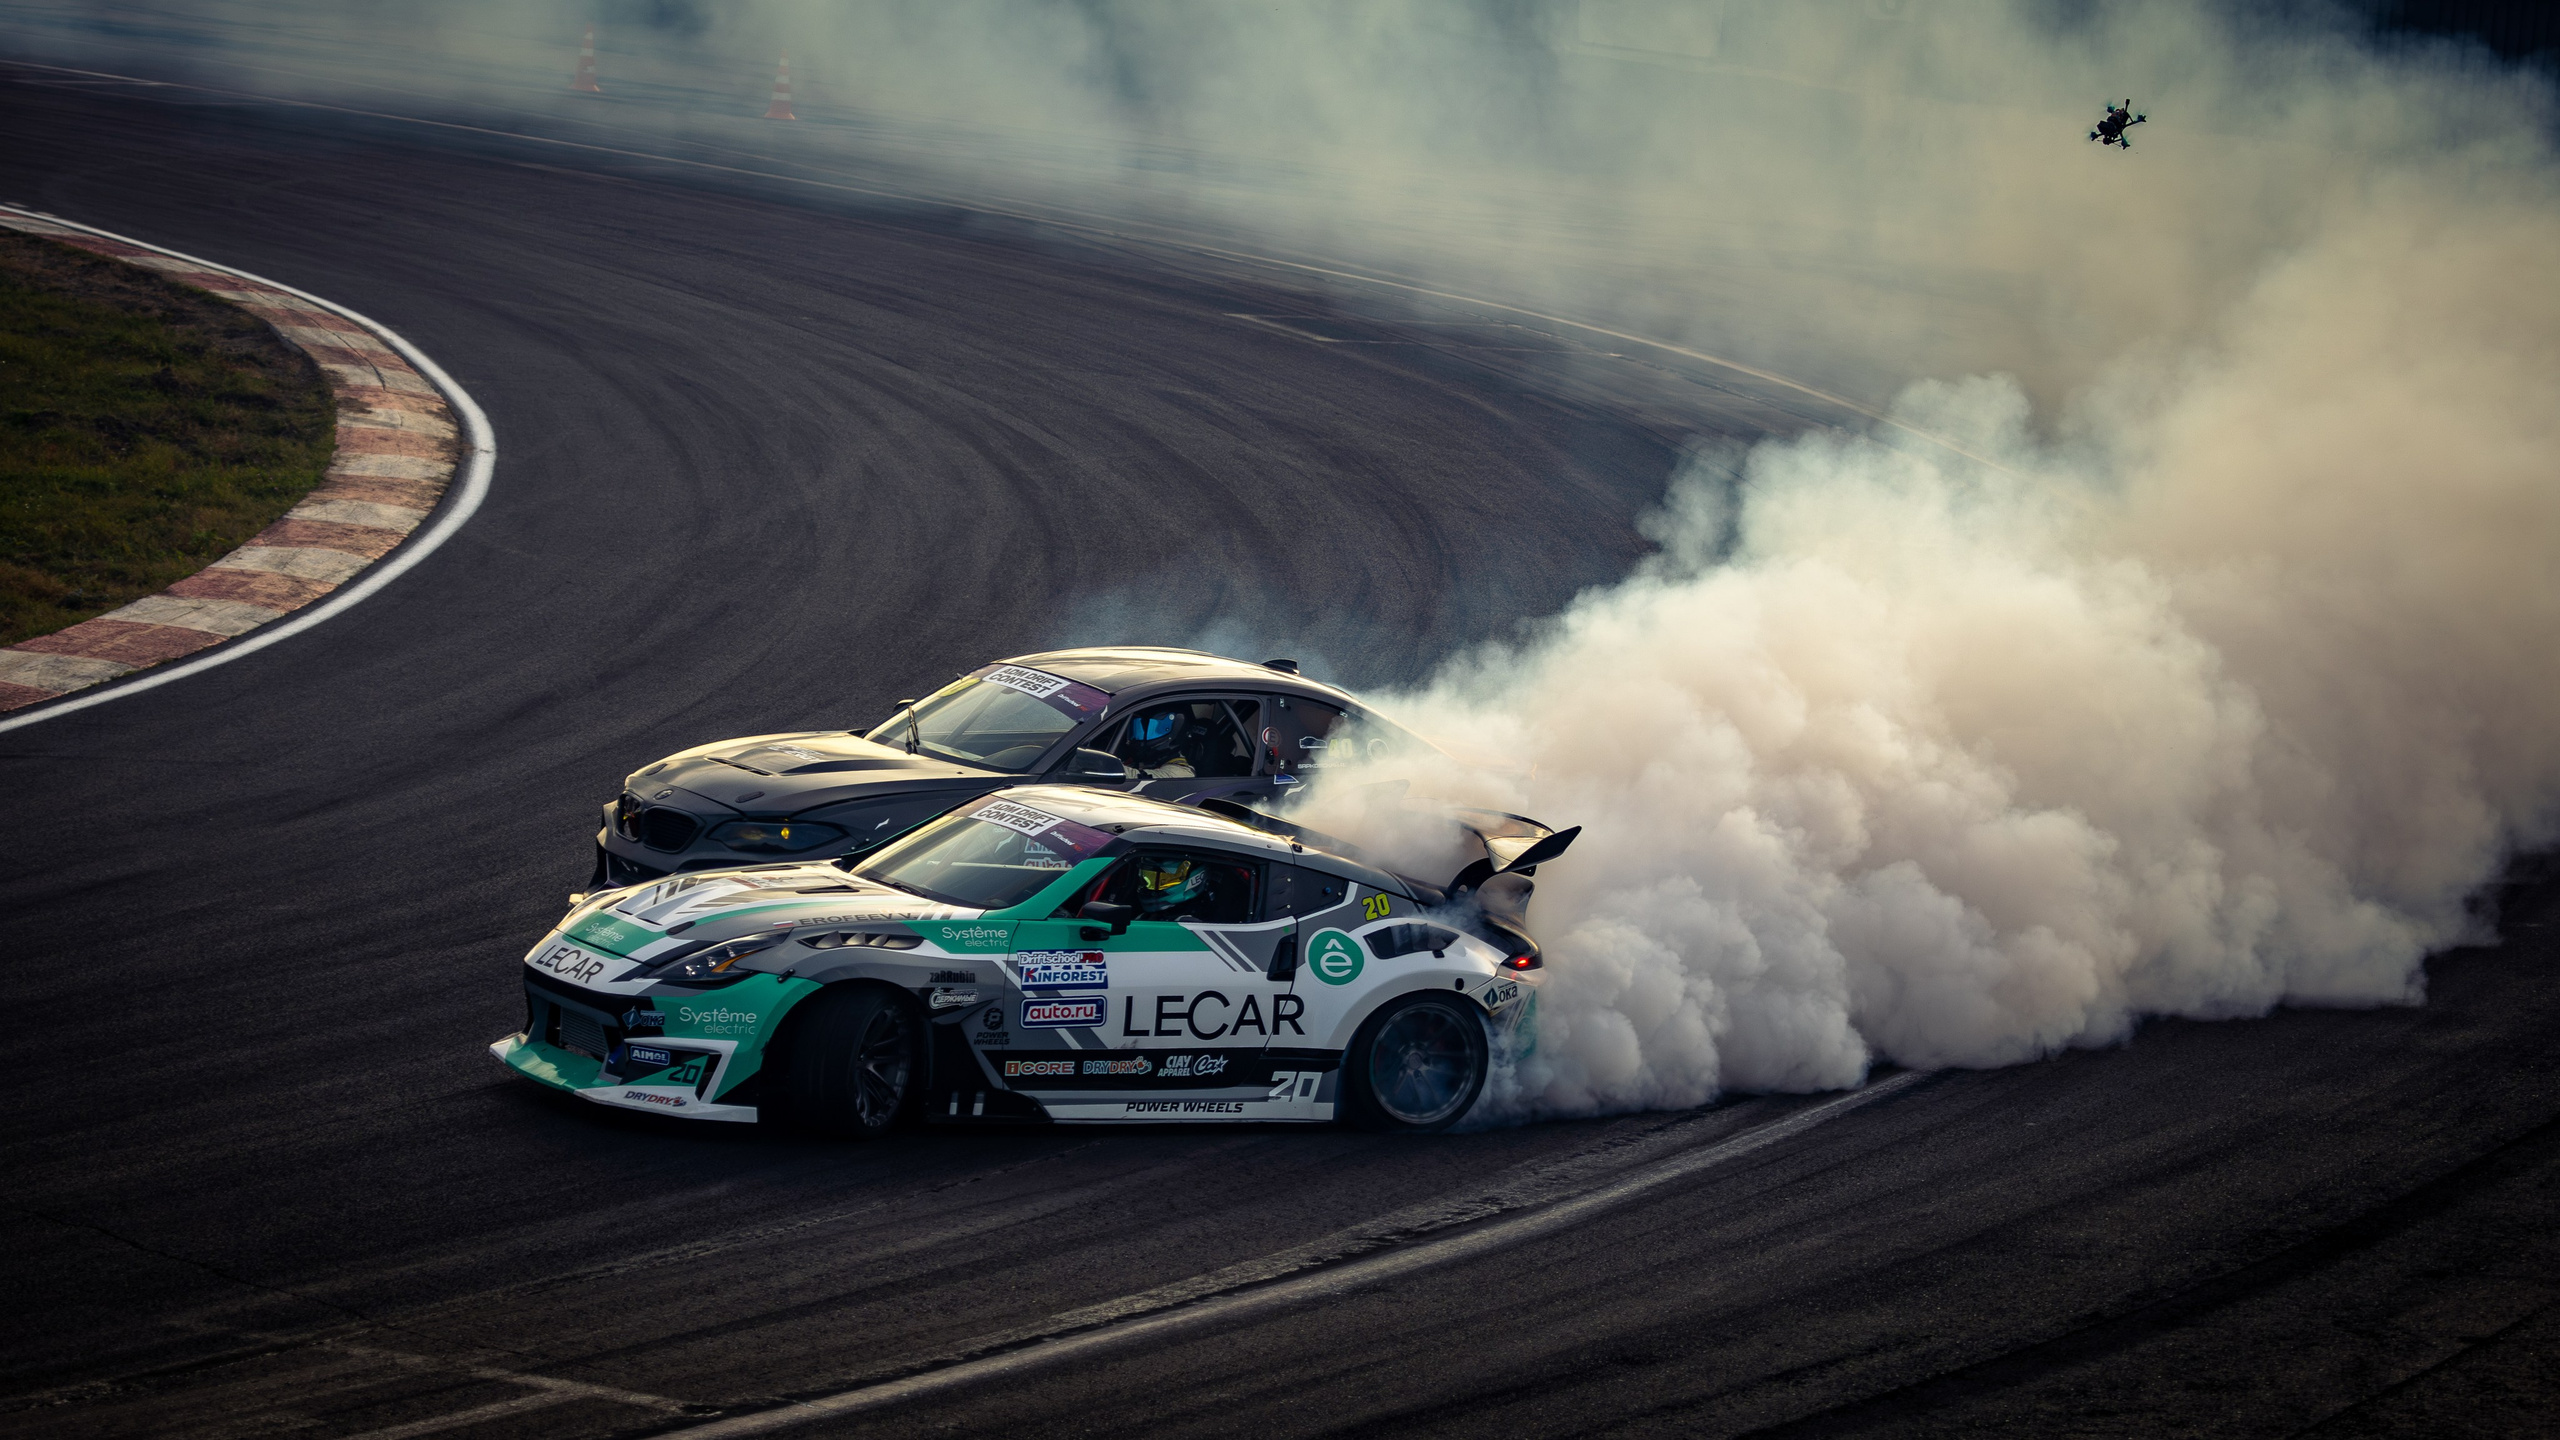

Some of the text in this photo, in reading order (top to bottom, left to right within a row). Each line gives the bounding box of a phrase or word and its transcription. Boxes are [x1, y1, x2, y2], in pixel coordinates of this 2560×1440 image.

[989, 674, 1052, 694] CONTEST
[1003, 668, 1062, 688] ADM DRIFT
[977, 810, 1044, 831] CONTEST
[991, 803, 1056, 824] ADM DRIFT
[1362, 893, 1391, 921] 20
[799, 913, 893, 925] EROFEEV
[942, 926, 1008, 941] Système
[965, 939, 1009, 947] electric
[535, 945, 604, 984] LECAR
[1020, 953, 1080, 964] Driftschool
[1319, 938, 1353, 978] ê
[1024, 967, 1105, 983] KINFOREST
[679, 1007, 757, 1025] Système
[1030, 1005, 1094, 1019] auto.ru
[1123, 990, 1306, 1040] LECAR
[704, 1023, 756, 1035] electric
[667, 1063, 702, 1085] 20
[1157, 1068, 1191, 1077] APPAREL
[1268, 1071, 1323, 1103] 20
[1126, 1102, 1244, 1113] POWER WHEELS
